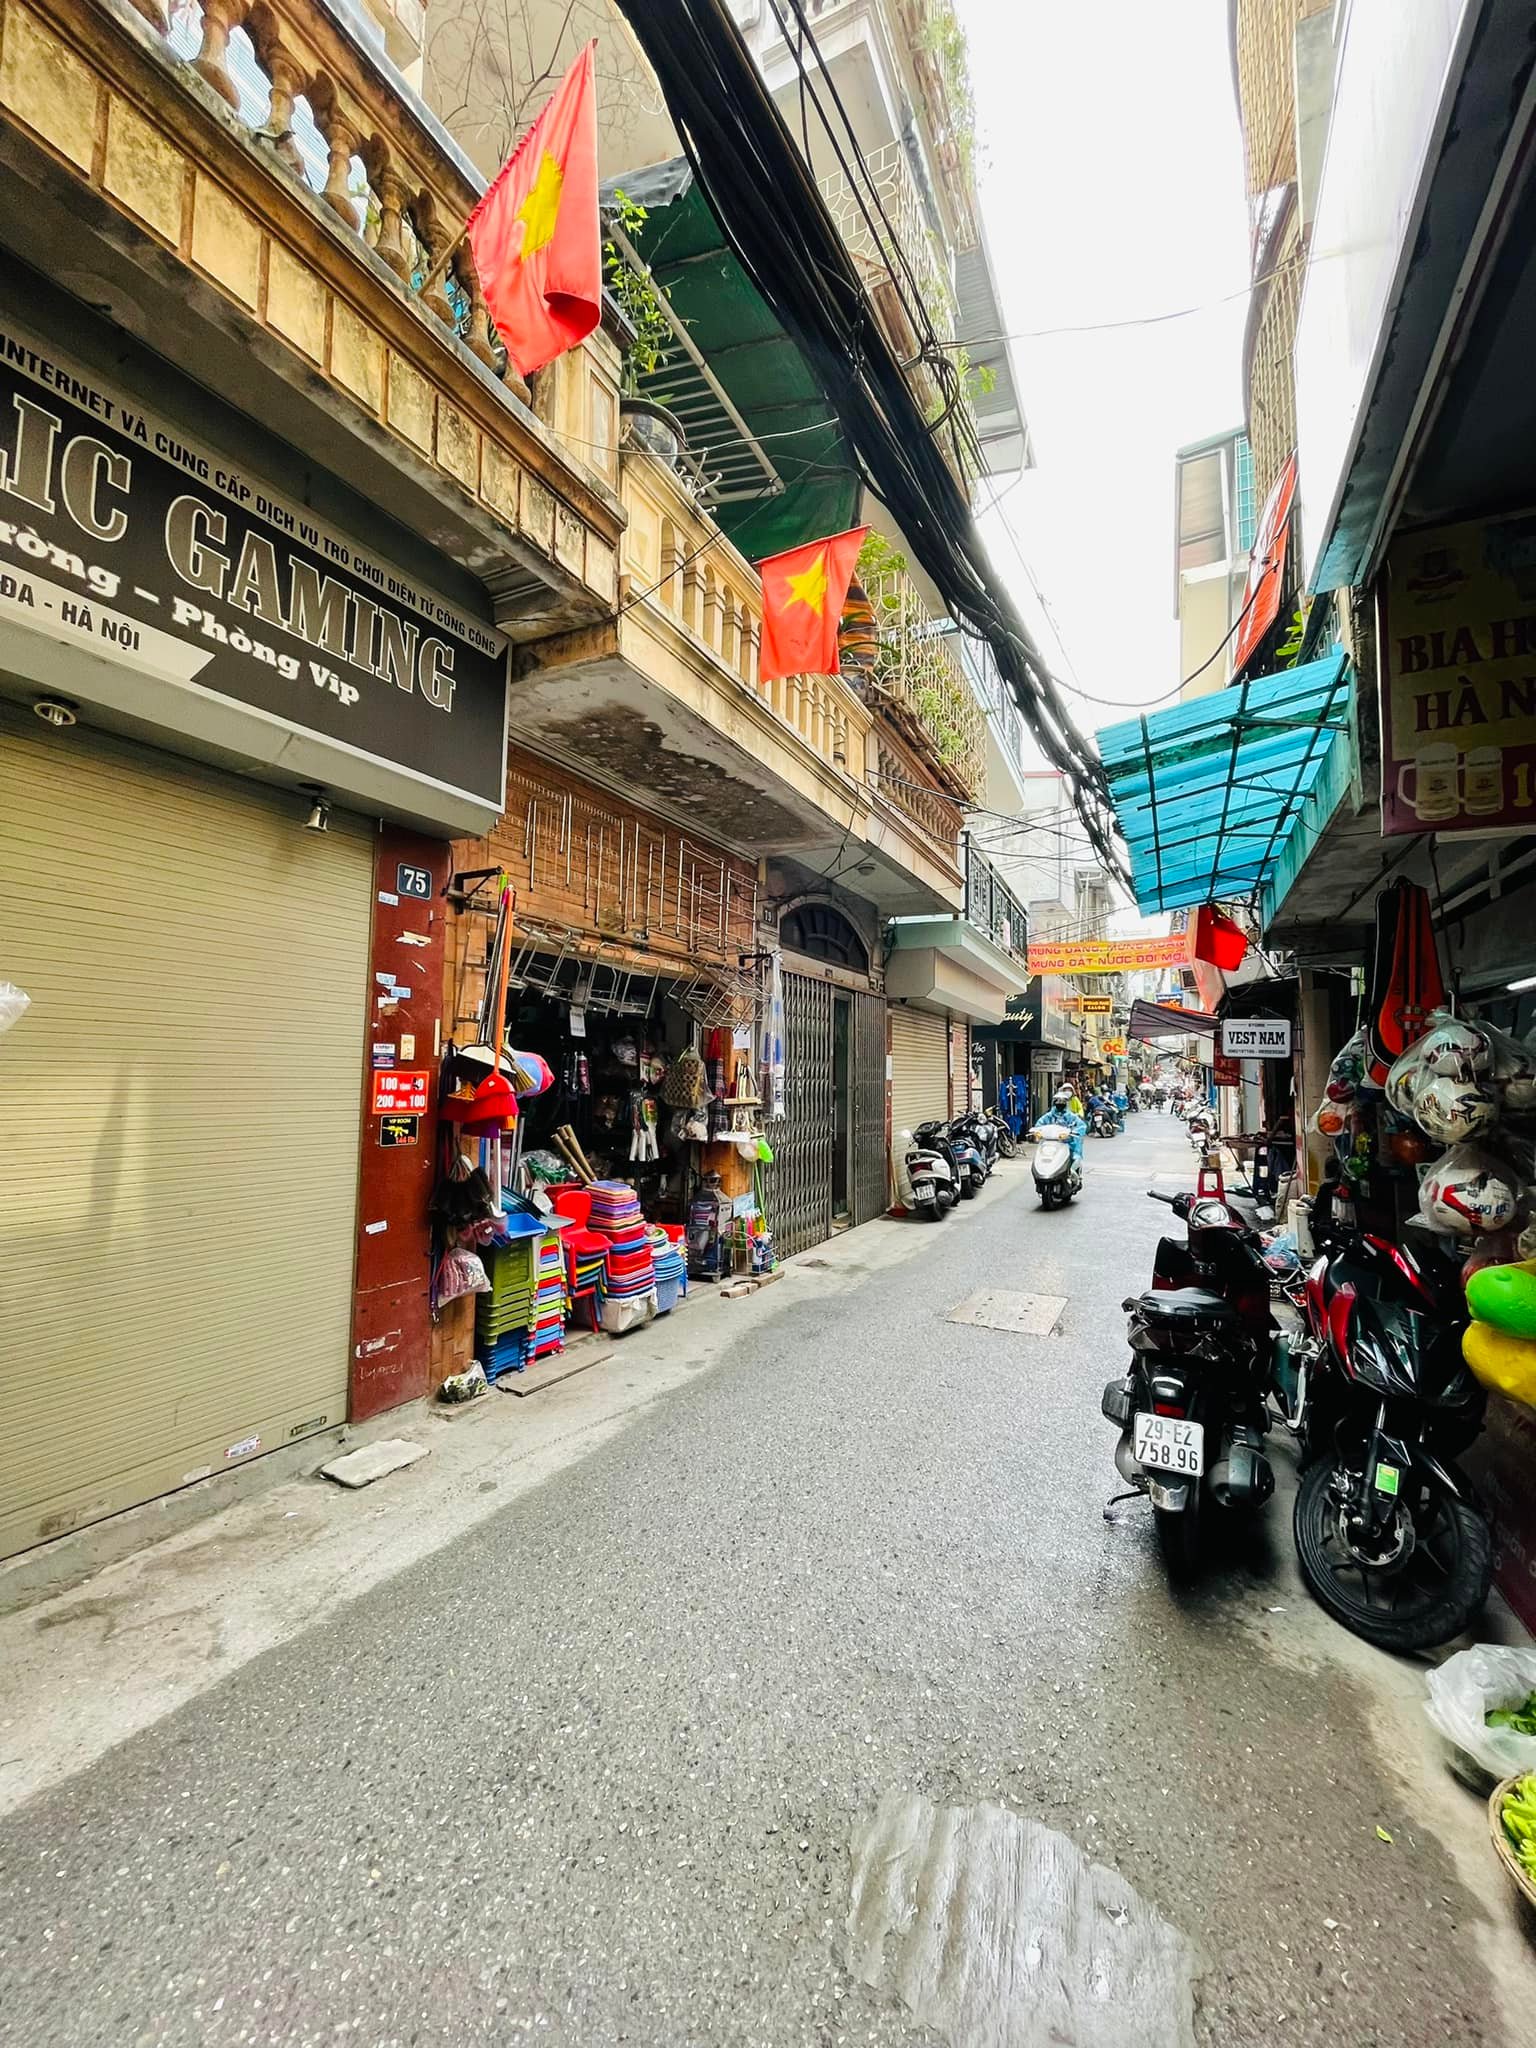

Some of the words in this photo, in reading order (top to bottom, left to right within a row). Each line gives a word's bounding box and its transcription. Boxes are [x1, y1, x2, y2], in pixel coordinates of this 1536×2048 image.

[0, 334, 116, 420] INTERNET
[121, 410, 148, 442] VÀ
[155, 432, 209, 480] CUNG
[215, 474, 251, 501] CẤP
[256, 498, 294, 532] DỊCH
[299, 521, 319, 549] VỤ
[324, 536, 350, 565] TRÒ
[353, 556, 384, 587] CHƠI
[387, 574, 416, 605] ĐIỆN
[436, 606, 466, 636] CÔNG
[468, 628, 497, 655] CỘNG
[0, 391, 132, 544] IC
[164, 494, 457, 713] GAMING
[61, 600, 93, 632] HÀ
[101, 617, 140, 651] NỘI
[172, 595, 301, 681] Phòng
[308, 660, 360, 707] Vip
[1397, 626, 1484, 675] BIA
[1414, 675, 1489, 733] HÀ
[404, 869, 427, 894] 75
[1228, 1031, 1257, 1045] VEST
[1258, 1031, 1286, 1046] NAM
[376, 1095, 395, 1108] 200
[409, 1094, 426, 1108] 100
[381, 1077, 398, 1091] 100
[1138, 1439, 1198, 1471] 758.96
